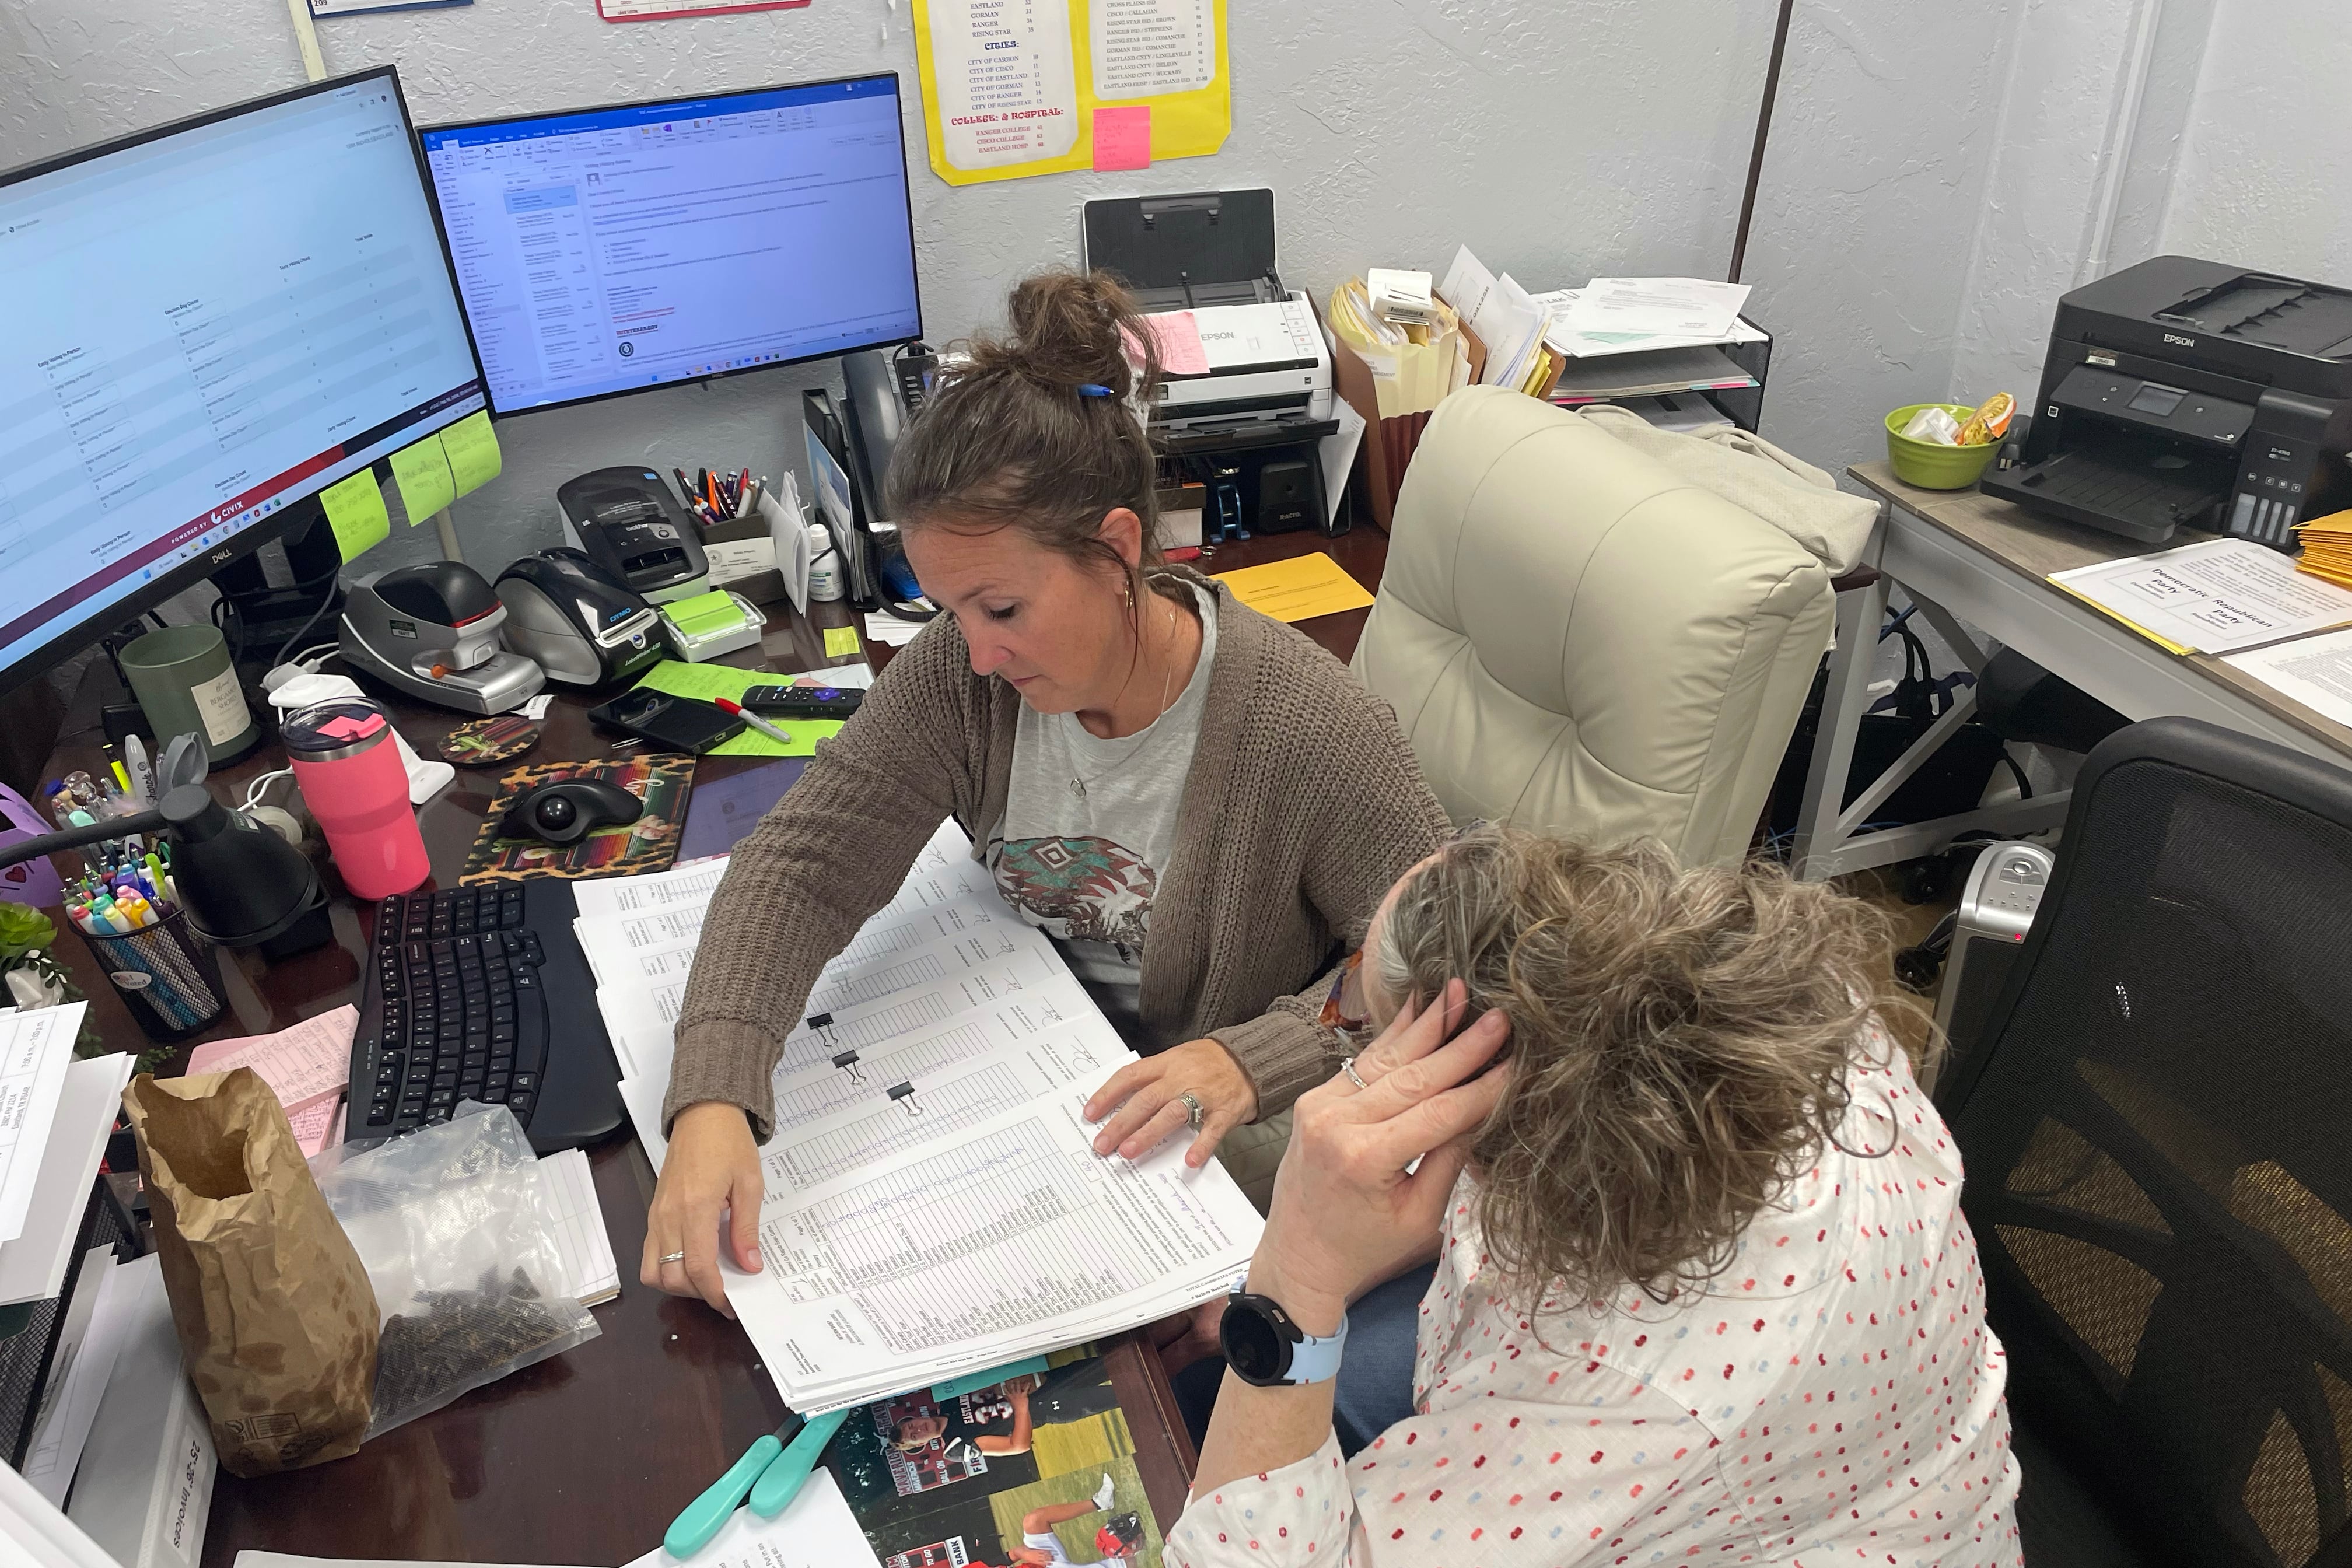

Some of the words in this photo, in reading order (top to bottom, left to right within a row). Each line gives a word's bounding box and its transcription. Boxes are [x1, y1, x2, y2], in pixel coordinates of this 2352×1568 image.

[985, 40, 1019, 50] CITIES:
[995, 73, 1027, 81] EASTLAND
[951, 114, 999, 125] COLLEGE:
[1011, 108, 1063, 119] HOSPITAL:
[1201, 331, 1234, 341] EPSON
[2164, 334, 2194, 346] EPSON
[222, 501, 243, 517] CIVIX
[170, 527, 198, 544] POWERED
[212, 548, 232, 564] DELL
[2152, 569, 2209, 598] Democratic
[2152, 579, 2180, 593] Party
[610, 607, 631, 622] DYMO
[2212, 599, 2272, 628] Republican
[2212, 609, 2244, 624] Party
[625, 648, 652, 666] LabelWriter
[1080, 1159, 1094, 1173] 40
[1037, 1187, 1049, 1203] General
[1044, 1184, 1056, 1199] General
[1023, 1193, 1035, 1209] General
[1046, 1201, 1060, 1217] Attorney
[1053, 1198, 1067, 1214] Attorney
[1021, 1204, 1035, 1222] Governor
[1031, 1206, 1046, 1224] Attorney
[795, 1224, 806, 1236] Page
[974, 1229, 988, 1247] Governor
[903, 1235, 923, 1261] Representative
[967, 1232, 981, 1250] Governor
[929, 1247, 943, 1264] Governor
[936, 1244, 950, 1262] Governor
[944, 1241, 958, 1258] Governor
[922, 1250, 935, 1266] Governor
[1094, 1280, 1103, 1290] Roy
[957, 1394, 974, 1424] EASTLAND
[183, 1440, 201, 1488] 25'-26'
[885, 1446, 912, 1497] MAVERICK
[936, 1459, 946, 1469] ON
[907, 1461, 922, 1491] MAVERICKS
[939, 1469, 949, 1483] BALL
[170, 1487, 192, 1548] Invoices
[923, 1548, 932, 1558] GO
[950, 1539, 964, 1565] BANK
